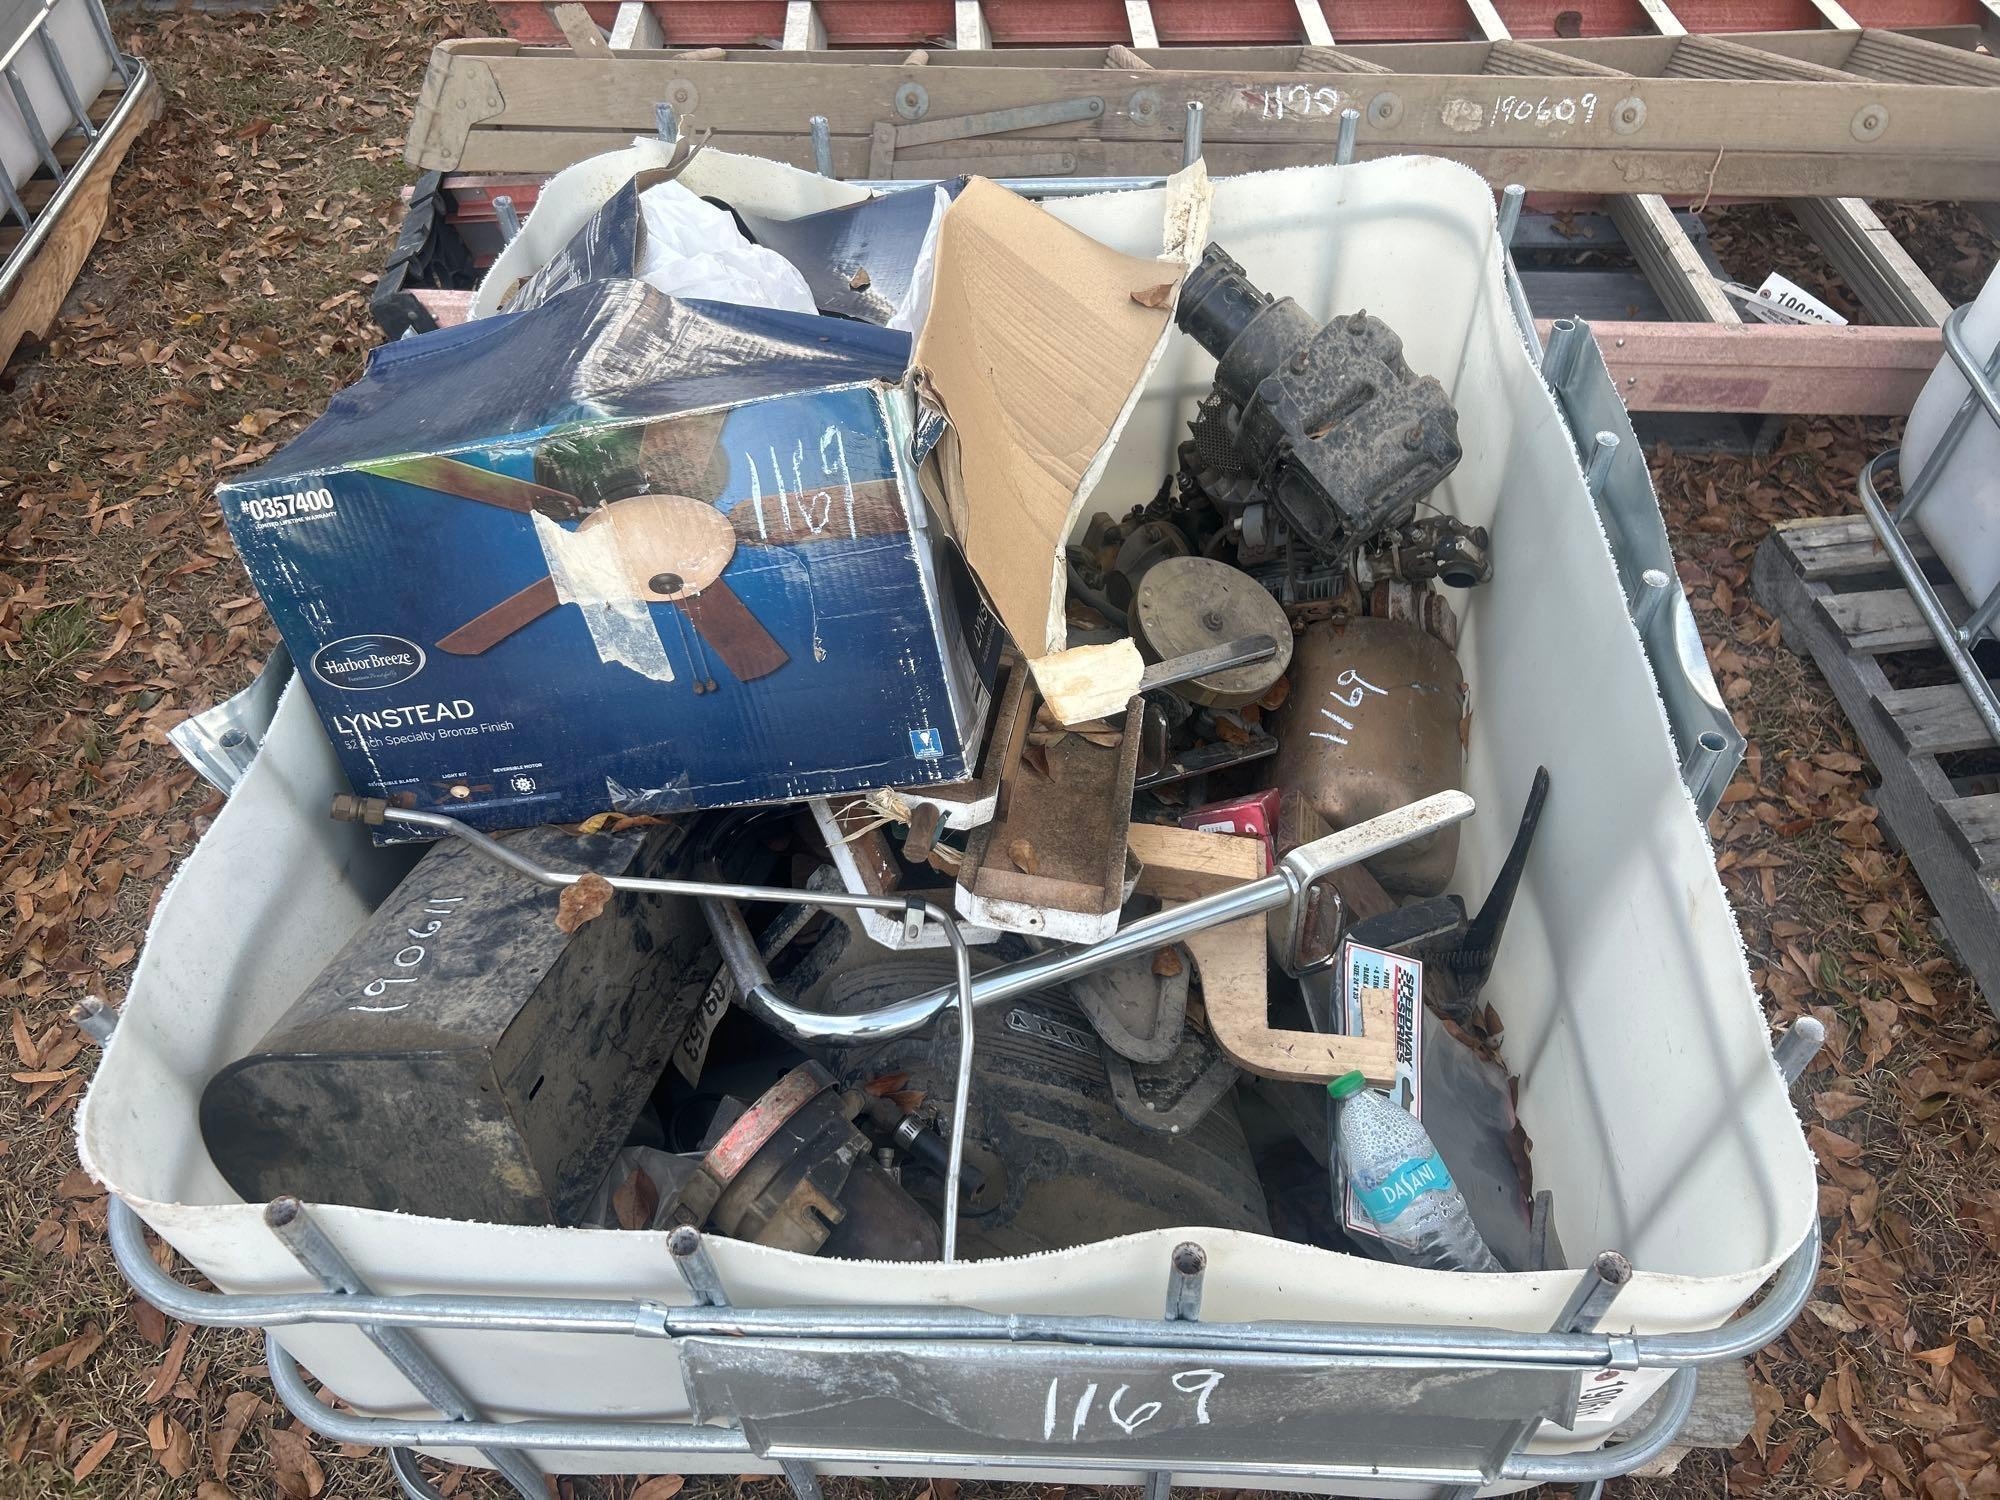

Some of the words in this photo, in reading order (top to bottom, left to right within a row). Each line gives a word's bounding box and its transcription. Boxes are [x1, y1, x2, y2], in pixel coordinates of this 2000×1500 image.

[1489, 92, 1599, 128] 190609
[744, 423, 858, 545] 1169
[240, 488, 334, 521] #0357400
[280, 516, 305, 527] LIFETIME
[304, 511, 338, 522] WARRANTY
[322, 657, 371, 675] Harbor
[369, 652, 415, 669] Breeze
[333, 699, 475, 735] LYNSTEAD
[1308, 668, 1390, 746] 1169
[385, 729, 437, 748] Specialty
[437, 724, 479, 739] Bronze
[480, 720, 515, 734] Finish
[492, 764, 523, 773] REVERSIBLE
[523, 762, 543, 770] MOTOR
[347, 896, 465, 1013] 190611
[1362, 967, 1370, 985] BLACK
[1396, 999, 1406, 1064] SERIES
[1402, 969, 1416, 1070] SPEEDWAY
[1381, 1162, 1436, 1205] DASANI
[1043, 1368, 1225, 1440] 1169
